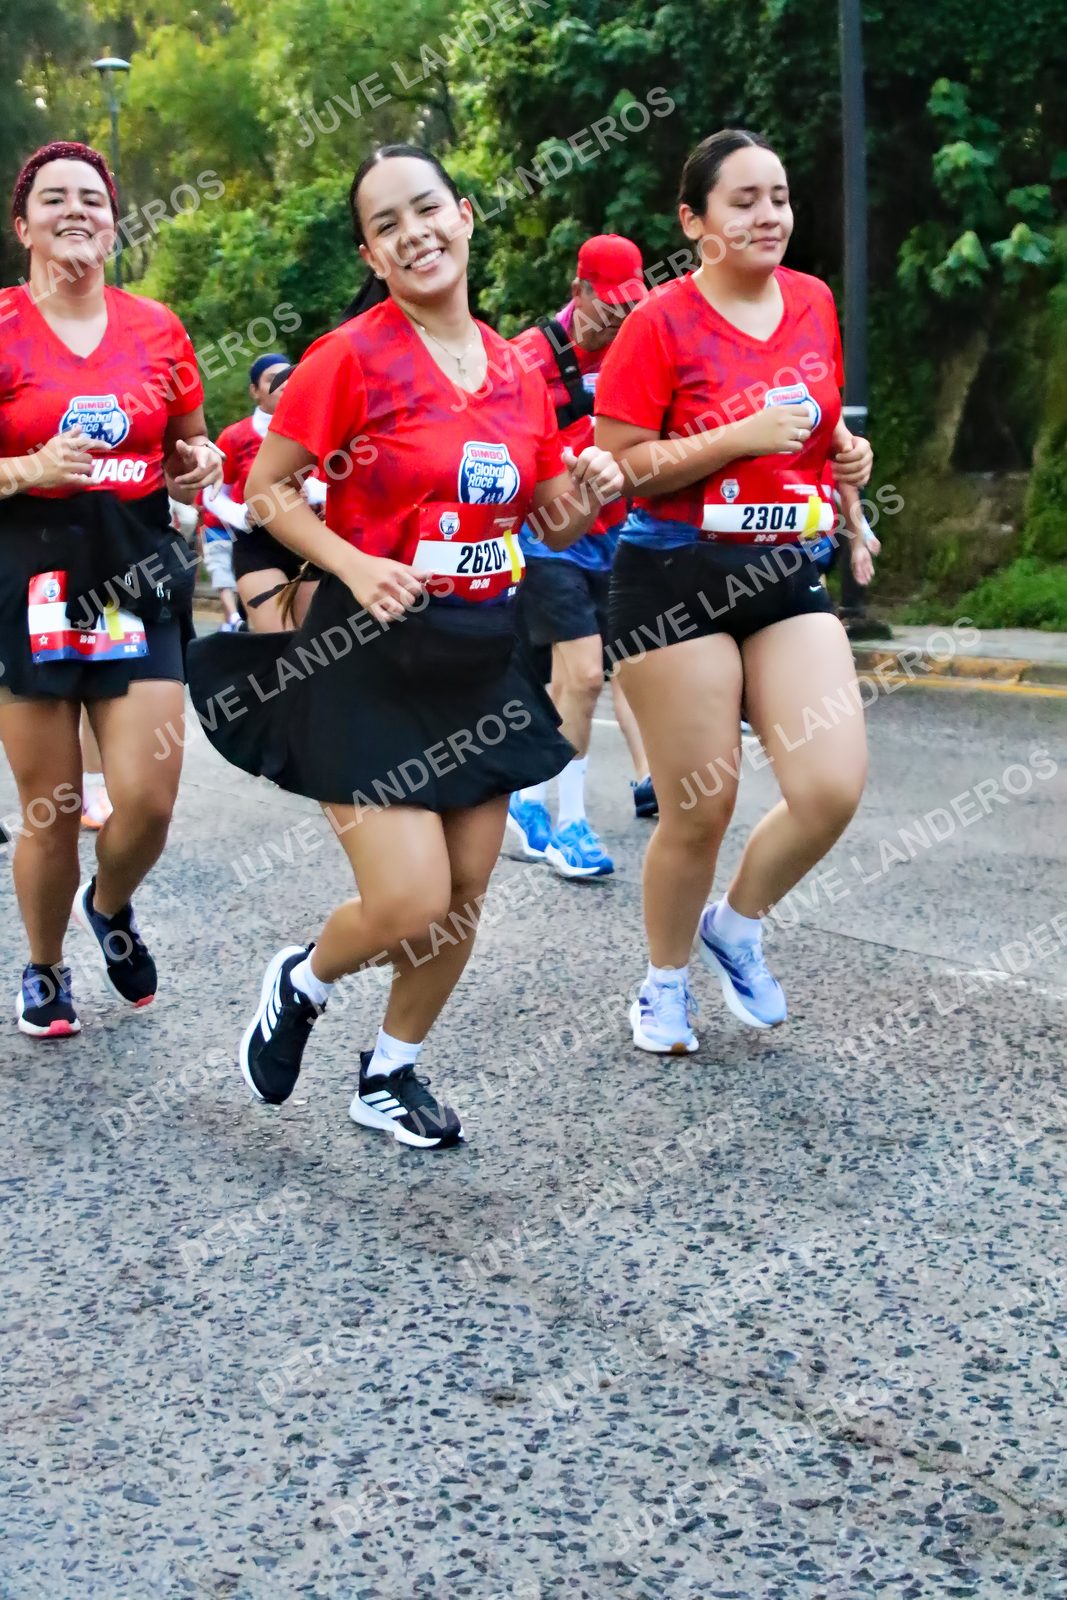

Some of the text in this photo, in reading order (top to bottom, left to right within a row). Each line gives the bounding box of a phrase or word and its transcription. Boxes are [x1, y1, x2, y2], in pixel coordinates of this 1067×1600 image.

[772, 391, 803, 403] BIMBO
[77, 401, 112, 409] BIMBO
[79, 411, 112, 424] Global
[470, 449, 504, 461] BIMBO
[91, 458, 147, 482] IAGO
[474, 462, 505, 479] Global
[467, 473, 494, 489] Race
[741, 506, 797, 531] 2304
